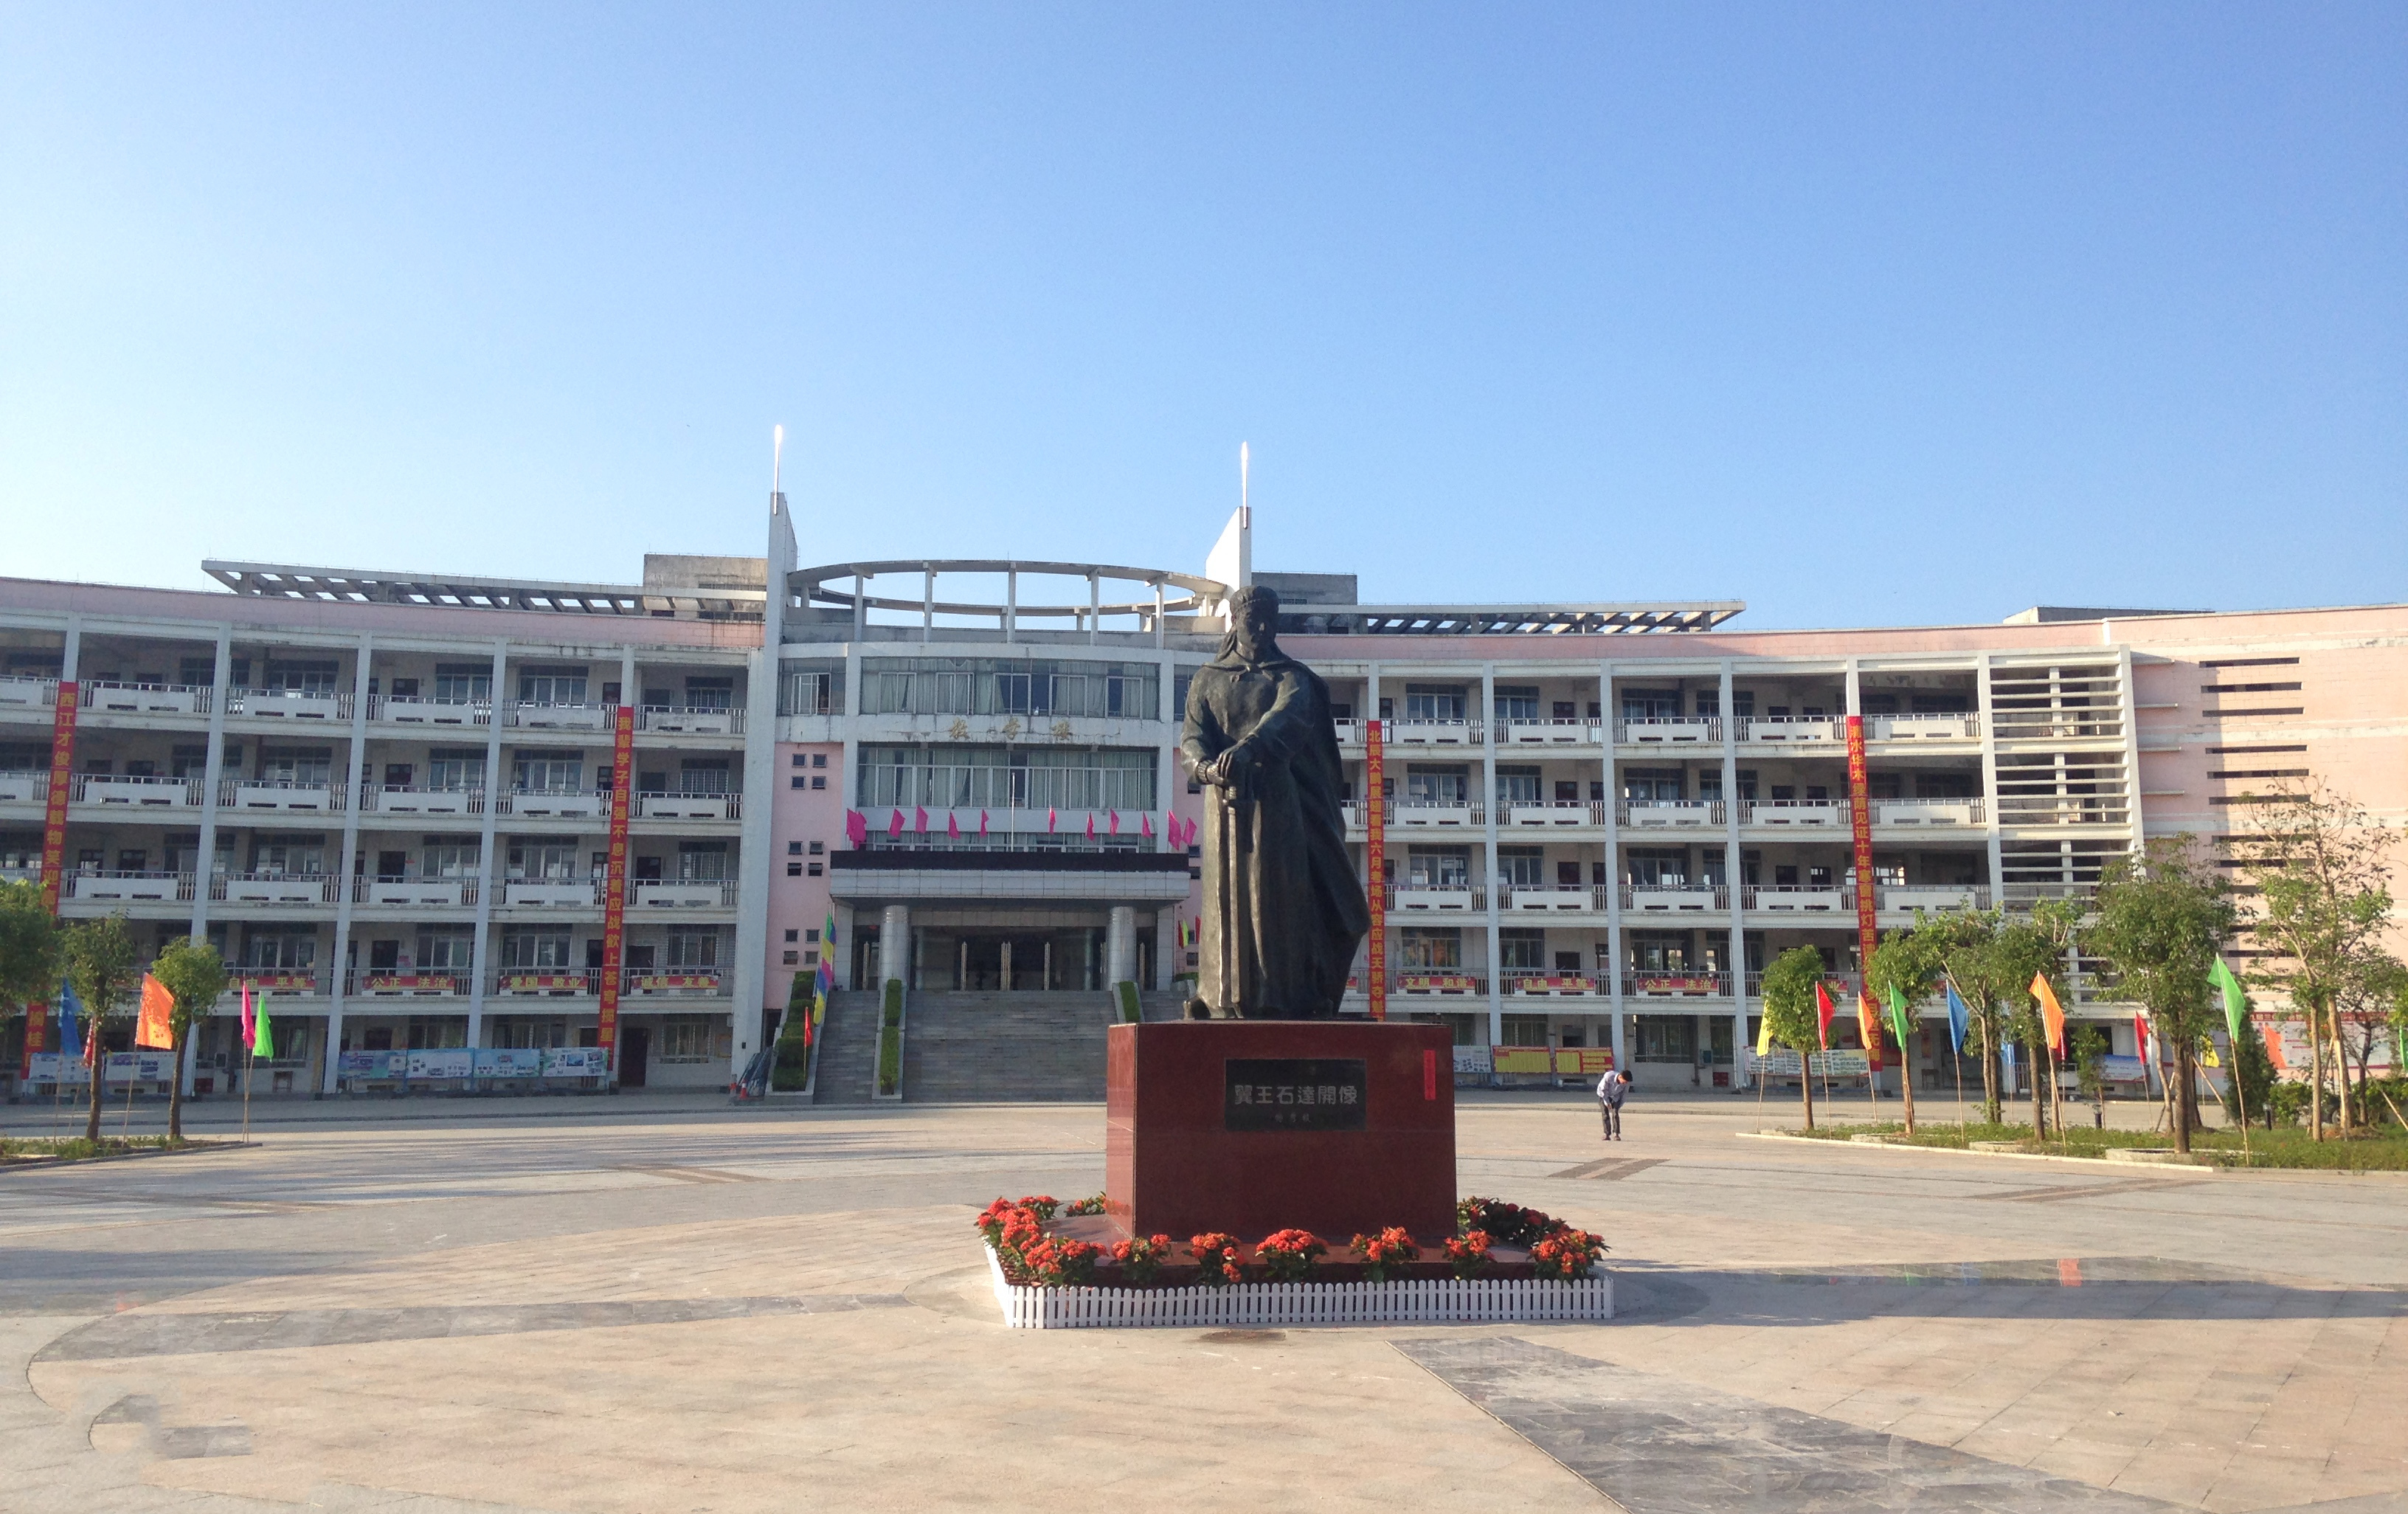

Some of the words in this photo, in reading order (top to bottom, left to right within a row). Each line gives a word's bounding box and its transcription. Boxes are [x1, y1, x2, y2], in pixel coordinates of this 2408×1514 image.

[600, 717, 632, 1057] 我辈学子自强不息沉着应战欲上苍穹揽星
[371, 977, 401, 988] 公正
[418, 977, 449, 988] 法治
[510, 977, 539, 988] 爱国
[1405, 978, 1430, 989] 文明
[1443, 978, 1468, 989] 和谐
[1523, 978, 1549, 989] 自由
[1645, 979, 1671, 989] 公正
[1685, 979, 1712, 990] 法治
[1234, 1085, 1358, 1105] 翼王石達開像
